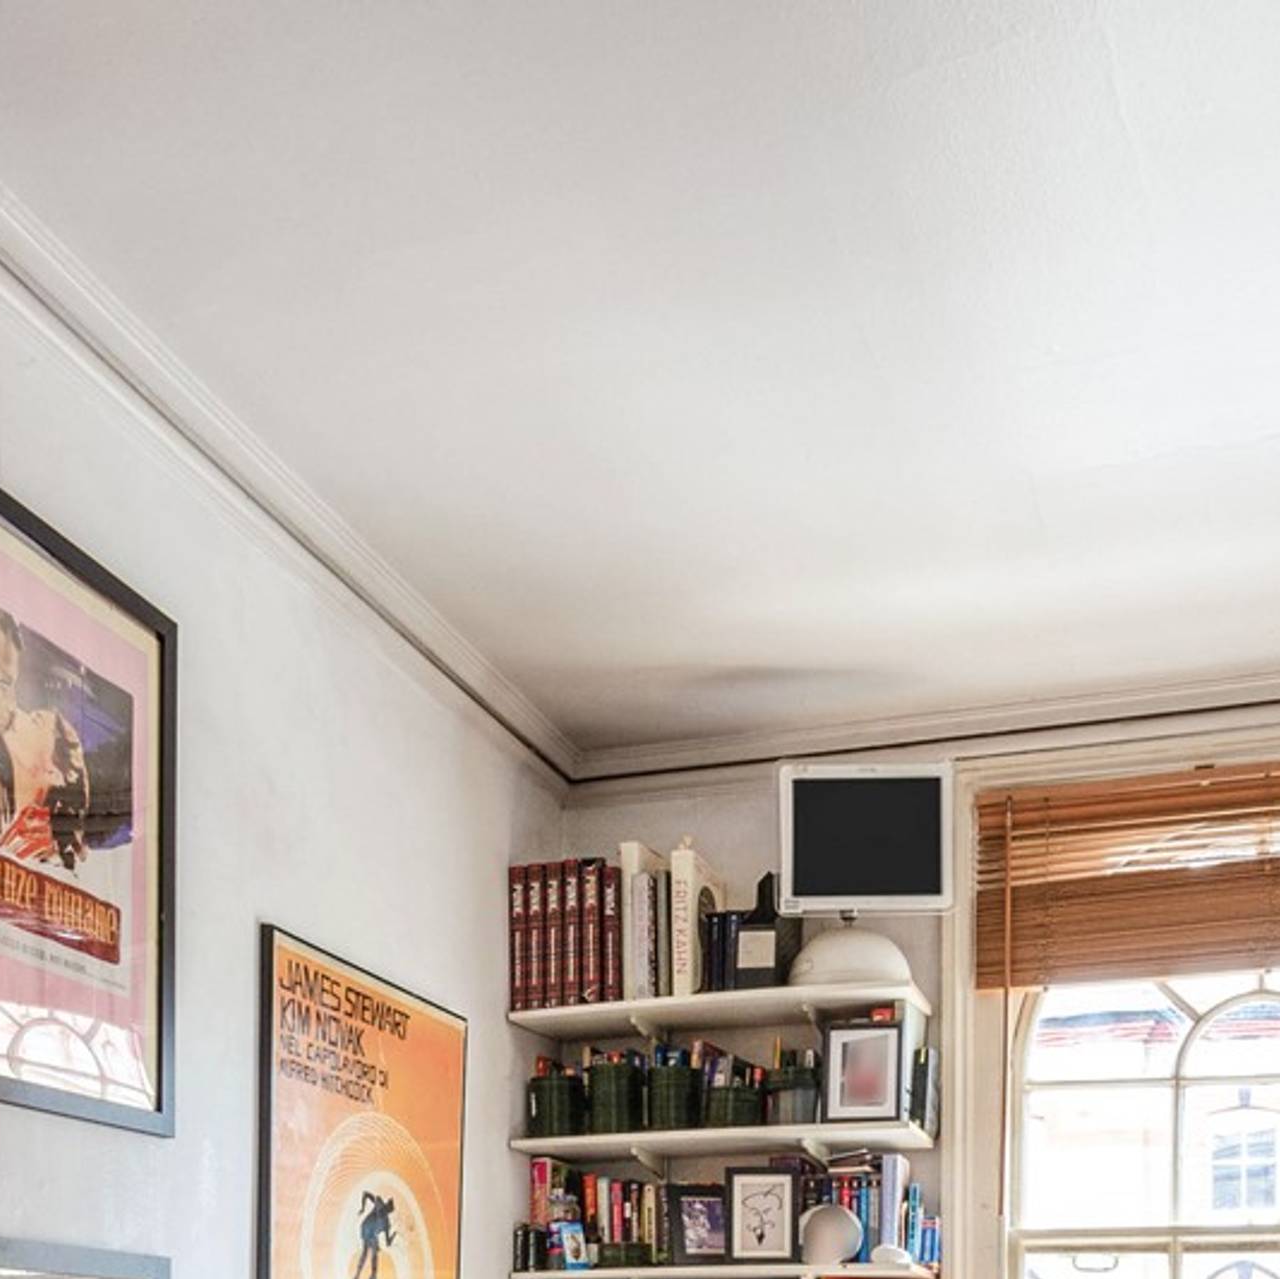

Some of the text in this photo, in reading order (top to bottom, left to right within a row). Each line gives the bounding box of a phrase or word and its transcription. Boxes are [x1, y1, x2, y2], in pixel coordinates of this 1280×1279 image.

[674, 879, 688, 975] FRITZ KAHN
[279, 959, 411, 1040] JAMES STEWART
[280, 996, 366, 1057] KIM NOVAK
[280, 1057, 375, 1104] ALFRED HITCHCOCK
